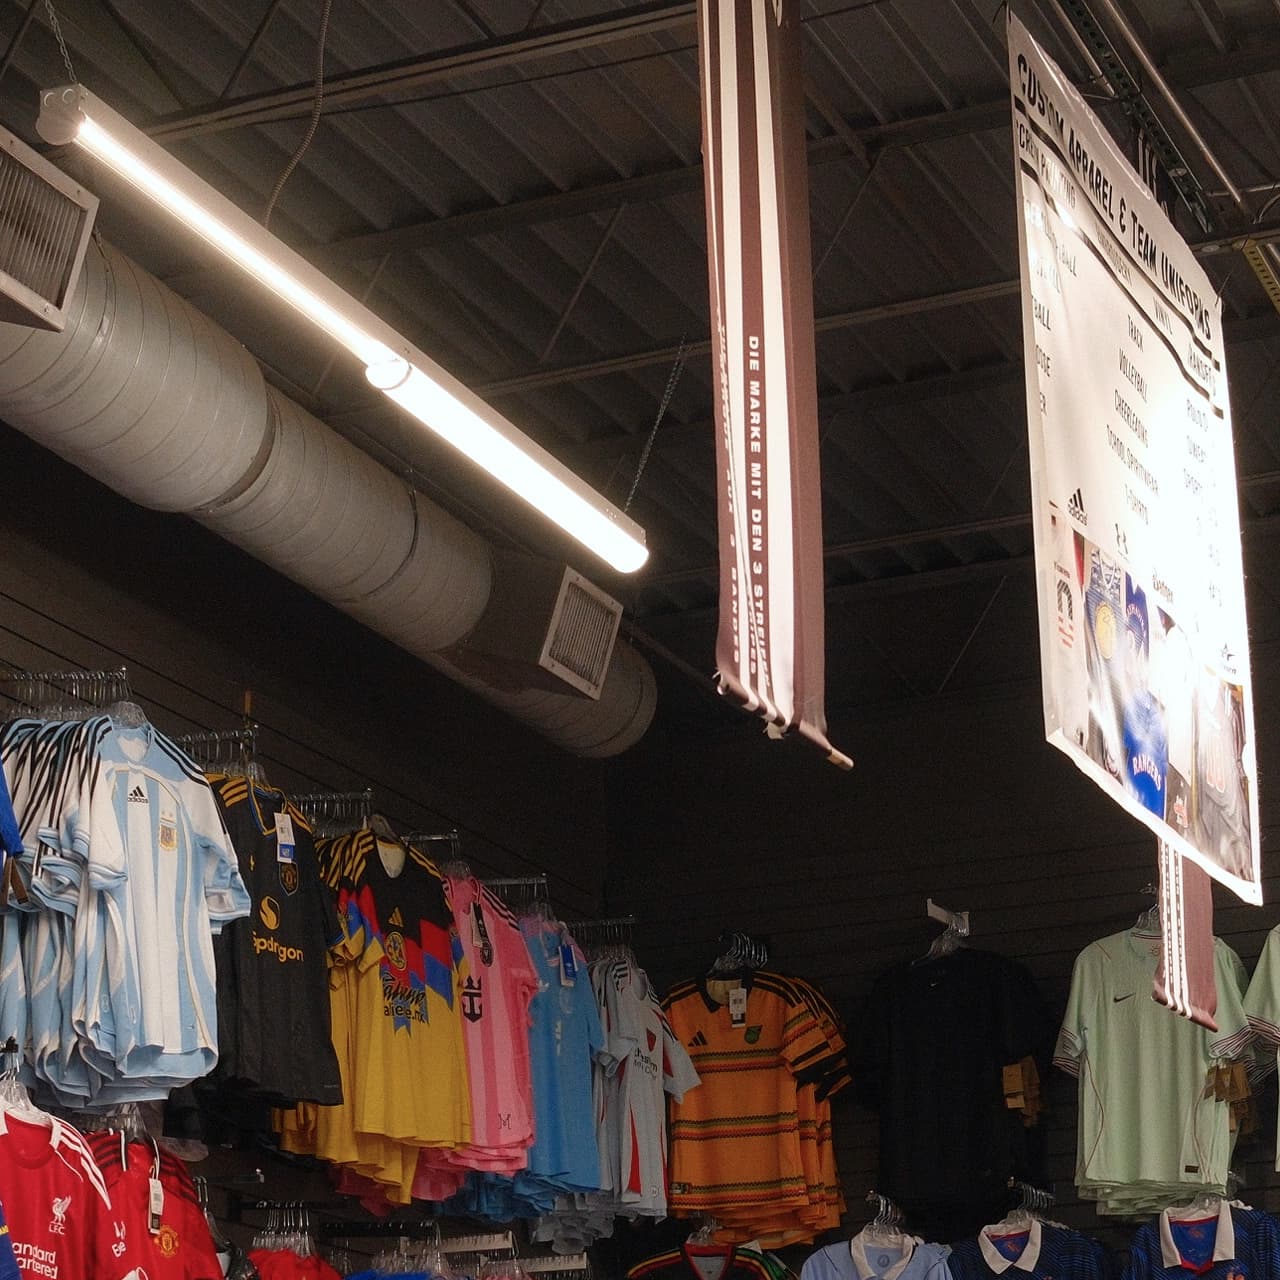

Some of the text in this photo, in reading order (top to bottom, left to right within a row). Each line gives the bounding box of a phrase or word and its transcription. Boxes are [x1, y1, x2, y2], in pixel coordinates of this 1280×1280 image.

[1069, 127, 1115, 222] APPAREL
[1120, 196, 1127, 234] &
[1131, 210, 1157, 277] TEAM
[1161, 251, 1212, 341] UNIFORMS
[1128, 314, 1144, 352] TRACK
[1153, 296, 1173, 336] VINYL
[749, 335, 759, 371] DIE
[1120, 347, 1147, 403] VOLLEYBALL
[749, 380, 761, 453] MARKE
[1115, 388, 1148, 449] CHEERLEADING
[1106, 423, 1126, 465] SCHOOL
[751, 462, 761, 499] MIT
[751, 508, 762, 552] DEN
[1068, 504, 1087, 526] adidas
[753, 560, 762, 575] 3
[1132, 752, 1161, 792] RANGERS
[48, 1222, 66, 1235] LFC
